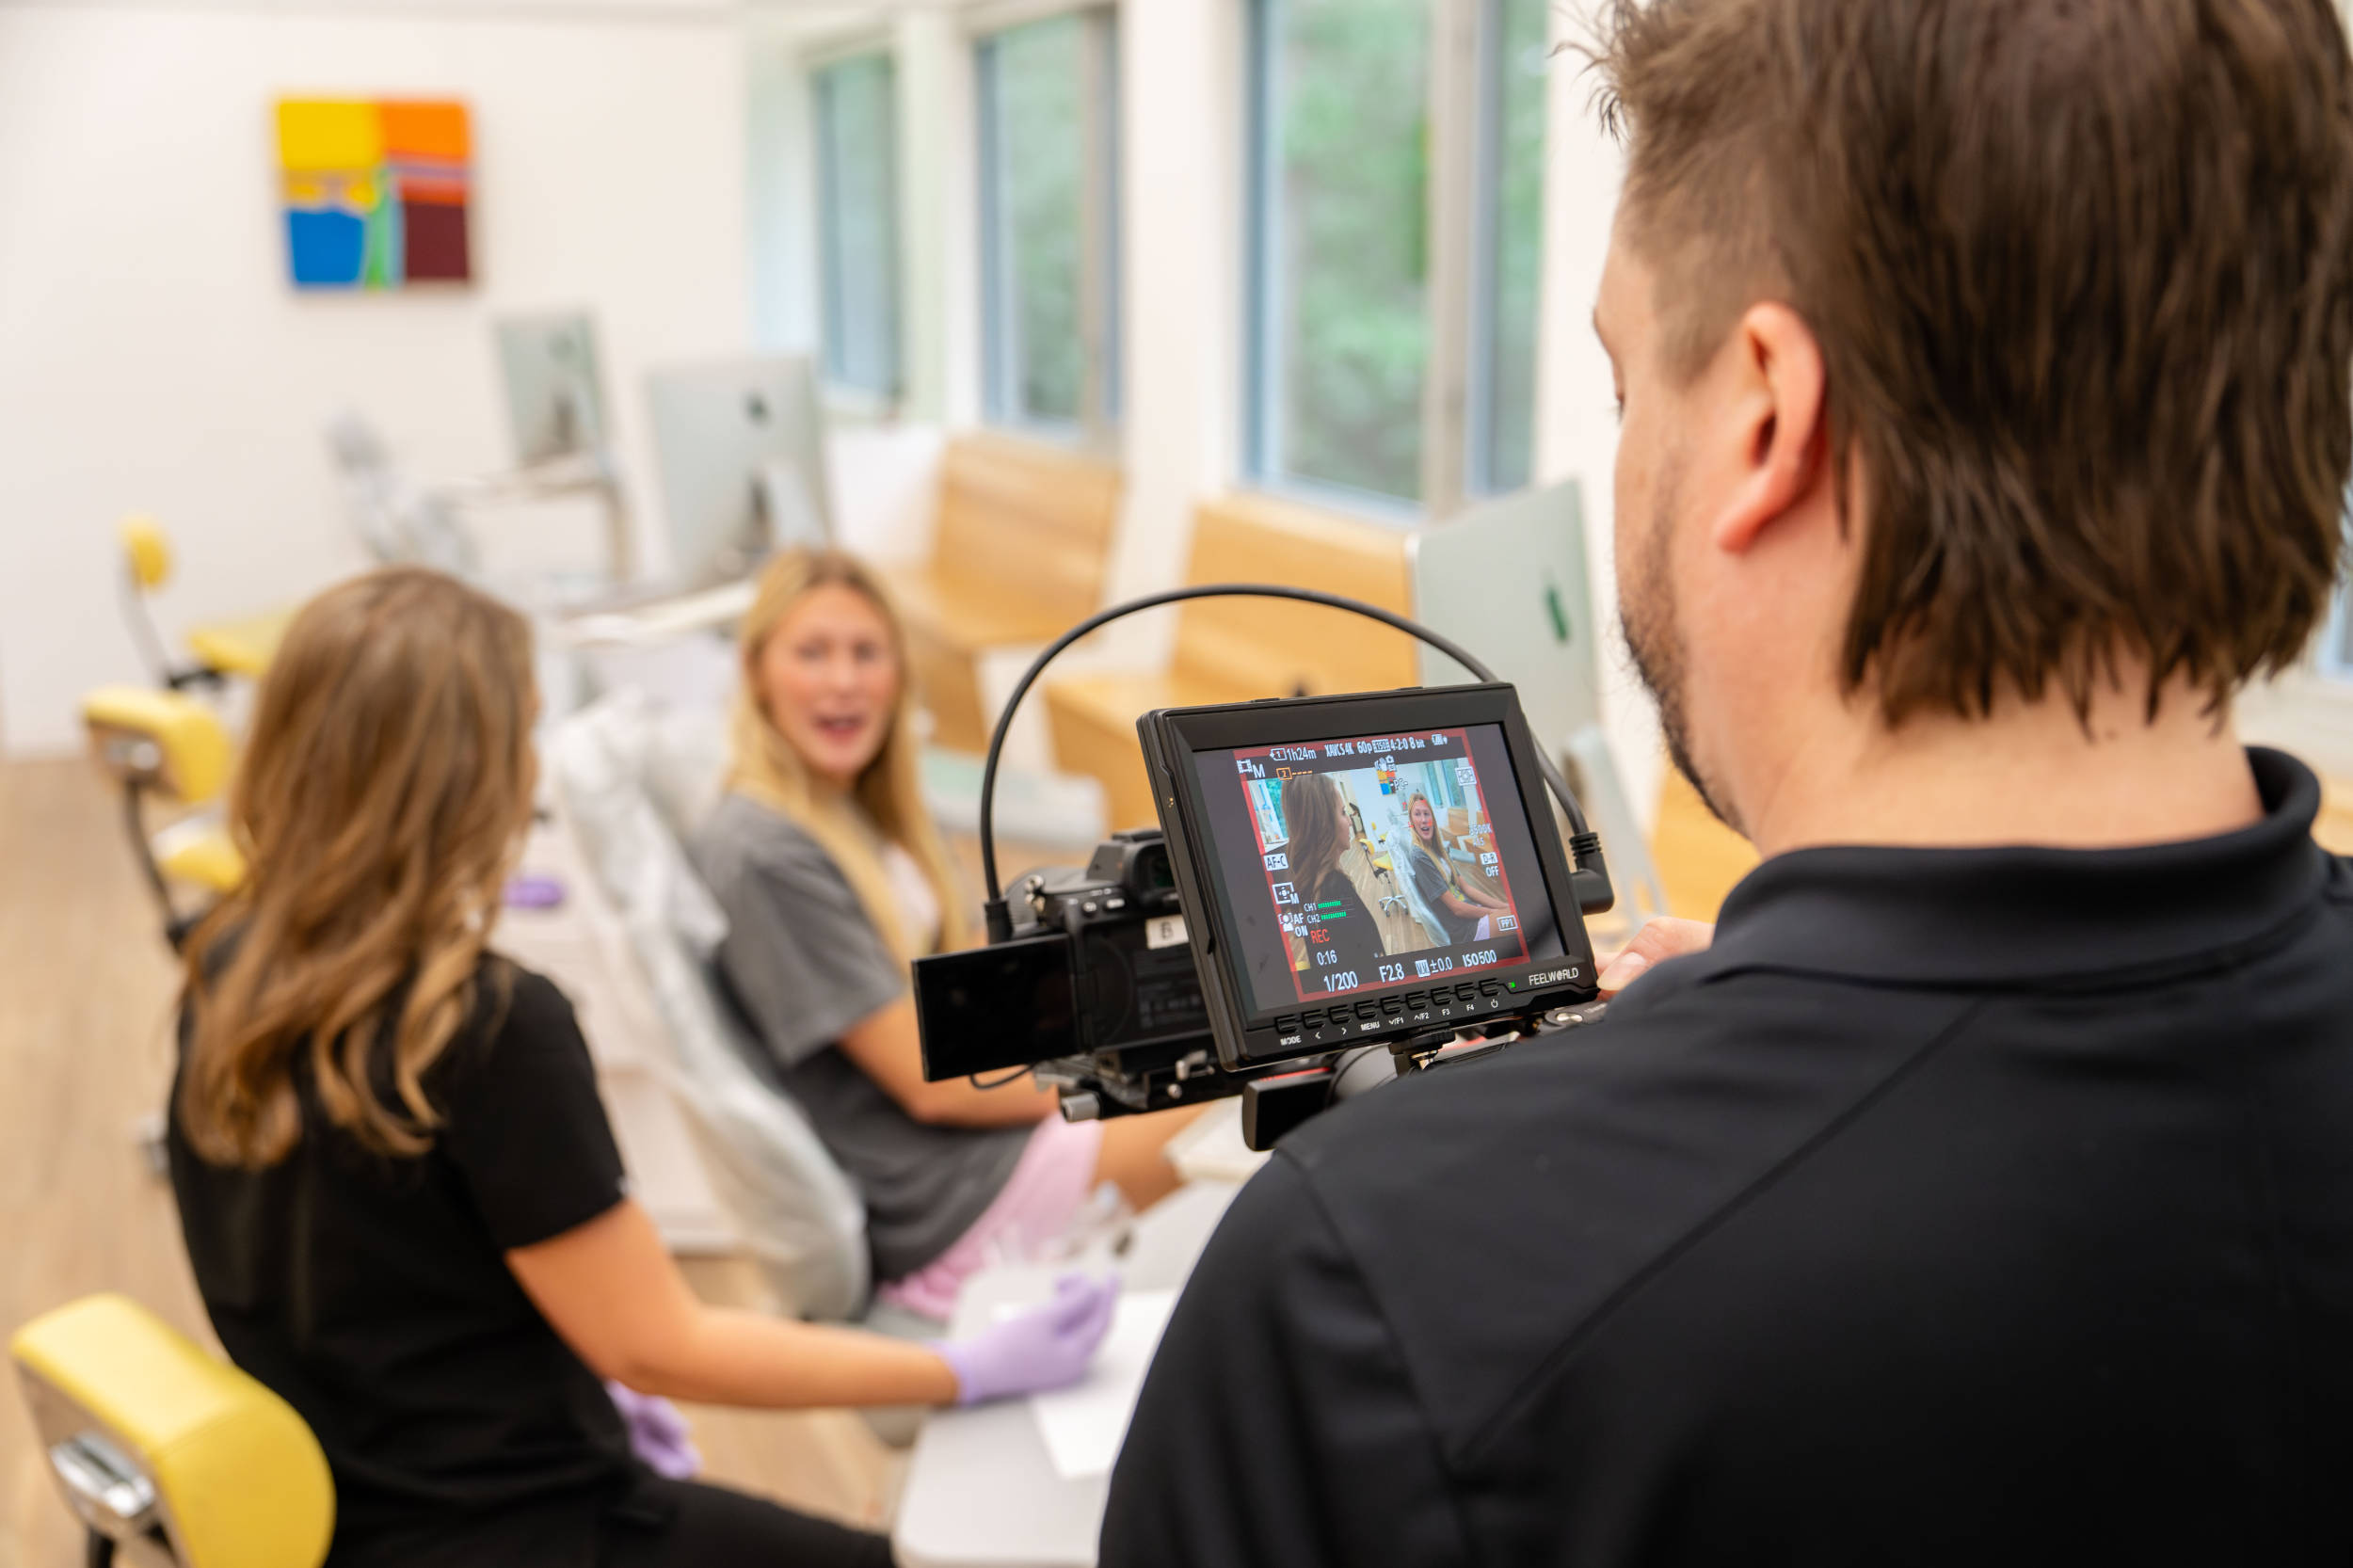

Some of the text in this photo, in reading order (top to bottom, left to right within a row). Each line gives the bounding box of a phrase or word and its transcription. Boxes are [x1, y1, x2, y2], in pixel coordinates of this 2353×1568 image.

[1287, 747, 1317, 760] 1h24m
[1357, 741, 1372, 754] 60p
[1390, 738, 1409, 750] 4:2:0
[1253, 763, 1266, 778] M
[1485, 865, 1498, 877] OFF
[1289, 892, 1299, 904] M
[1304, 903, 1317, 912] CH1
[1293, 913, 1305, 924] AF
[1306, 913, 1321, 924] CH2
[1294, 924, 1309, 937] ON
[1310, 928, 1330, 944] REC
[1317, 950, 1337, 966] 0:16
[1323, 971, 1358, 992] 1/200
[1379, 963, 1405, 983] F2.8
[1280, 1035, 1302, 1046] MODE
[1360, 1021, 1380, 1031] MENU
[1442, 1008, 1450, 1016] F3
[1466, 1003, 1475, 1012] F4
